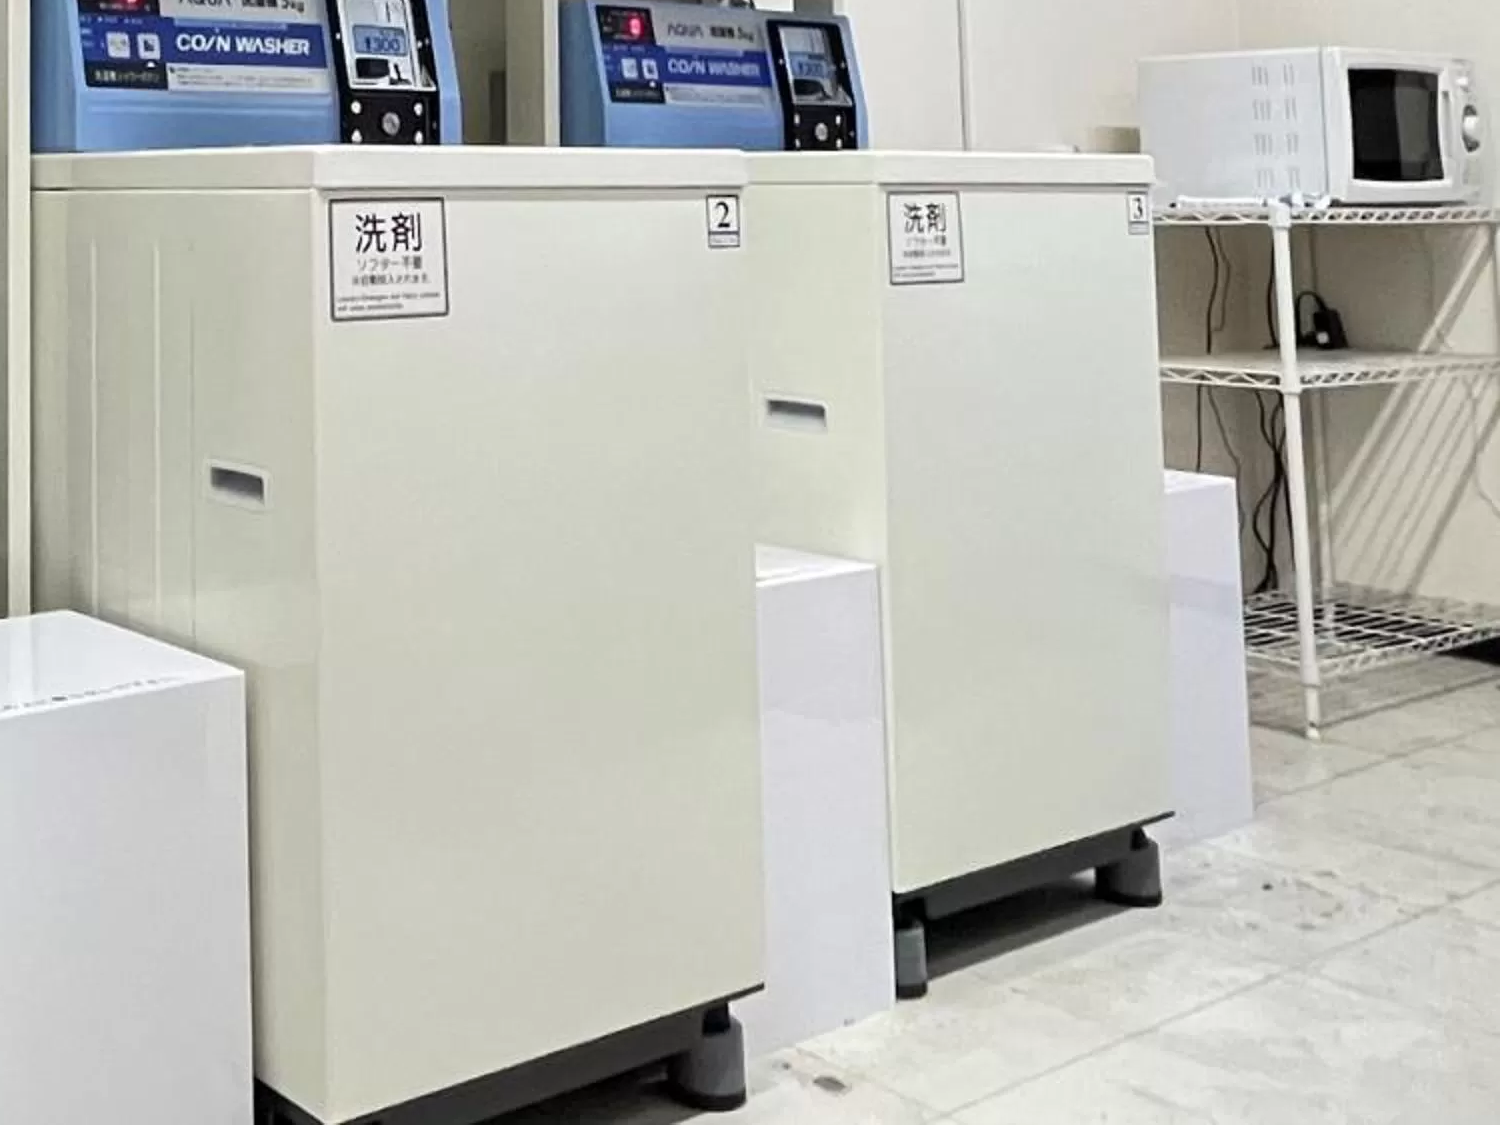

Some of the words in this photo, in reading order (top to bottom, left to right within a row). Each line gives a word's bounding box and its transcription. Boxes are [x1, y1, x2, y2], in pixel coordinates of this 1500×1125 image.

[234, 35, 311, 56] WASHER
[714, 201, 730, 228] 2
[355, 211, 422, 254] 洗剤
